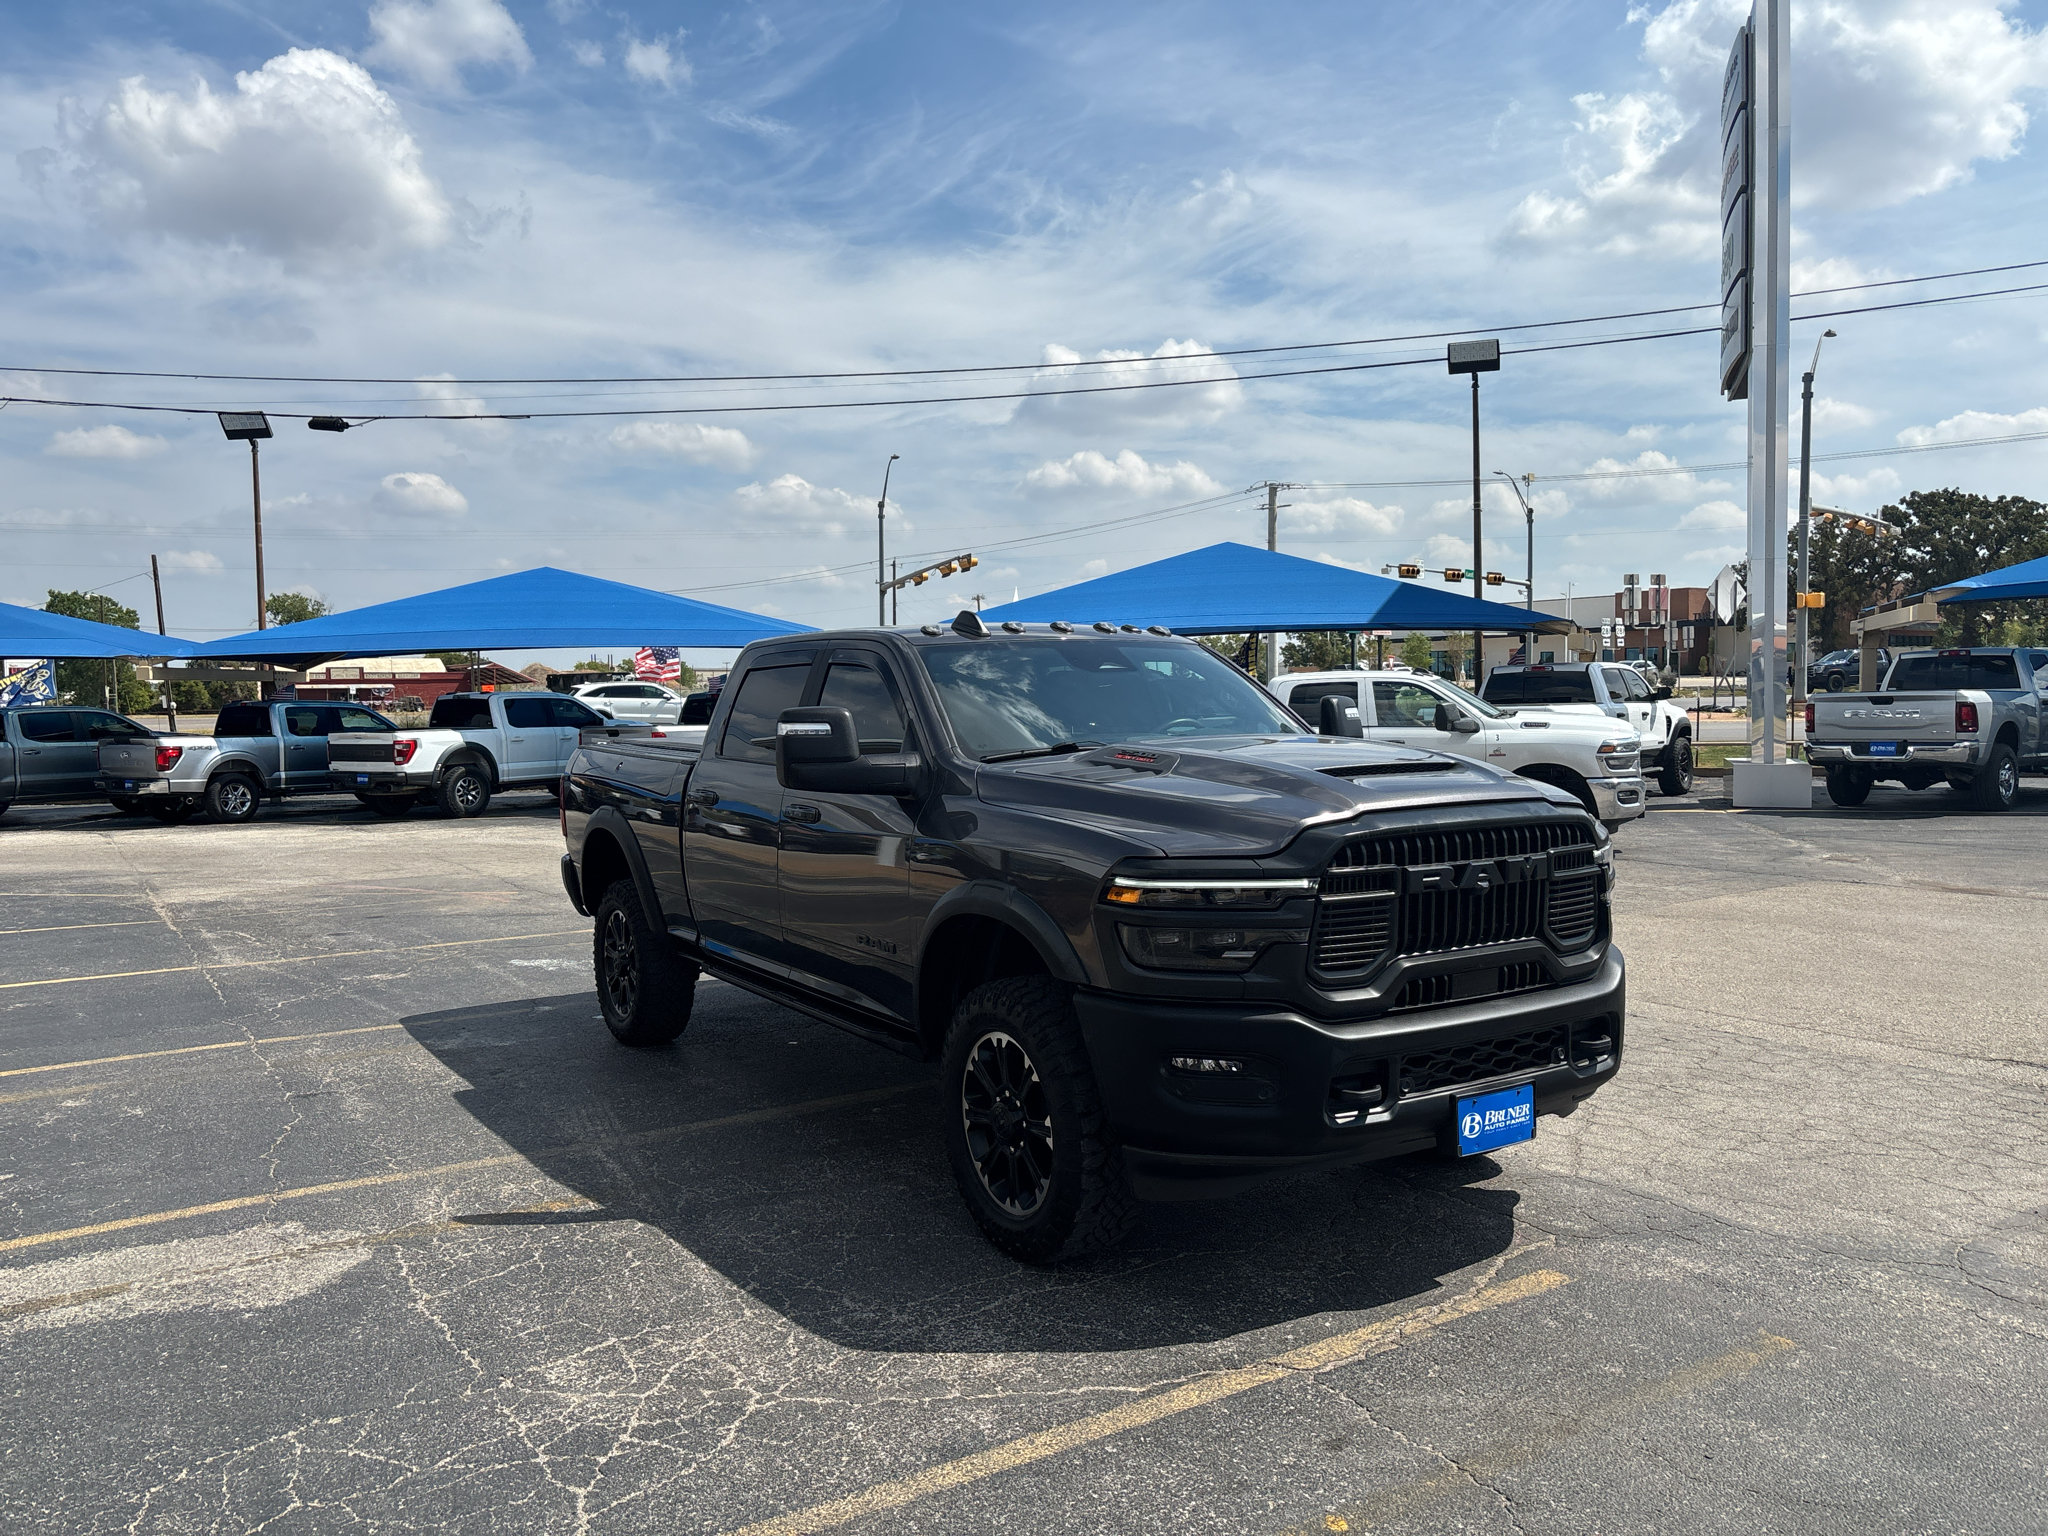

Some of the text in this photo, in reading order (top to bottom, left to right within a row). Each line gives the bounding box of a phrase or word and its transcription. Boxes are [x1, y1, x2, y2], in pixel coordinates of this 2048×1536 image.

[1844, 709, 1920, 718] RAM
[1407, 853, 1548, 893] RAM
[1484, 1103, 1530, 1126] BRUNER
[1484, 1121, 1505, 1131] AUTO
[1506, 1115, 1530, 1126] FAMILY
